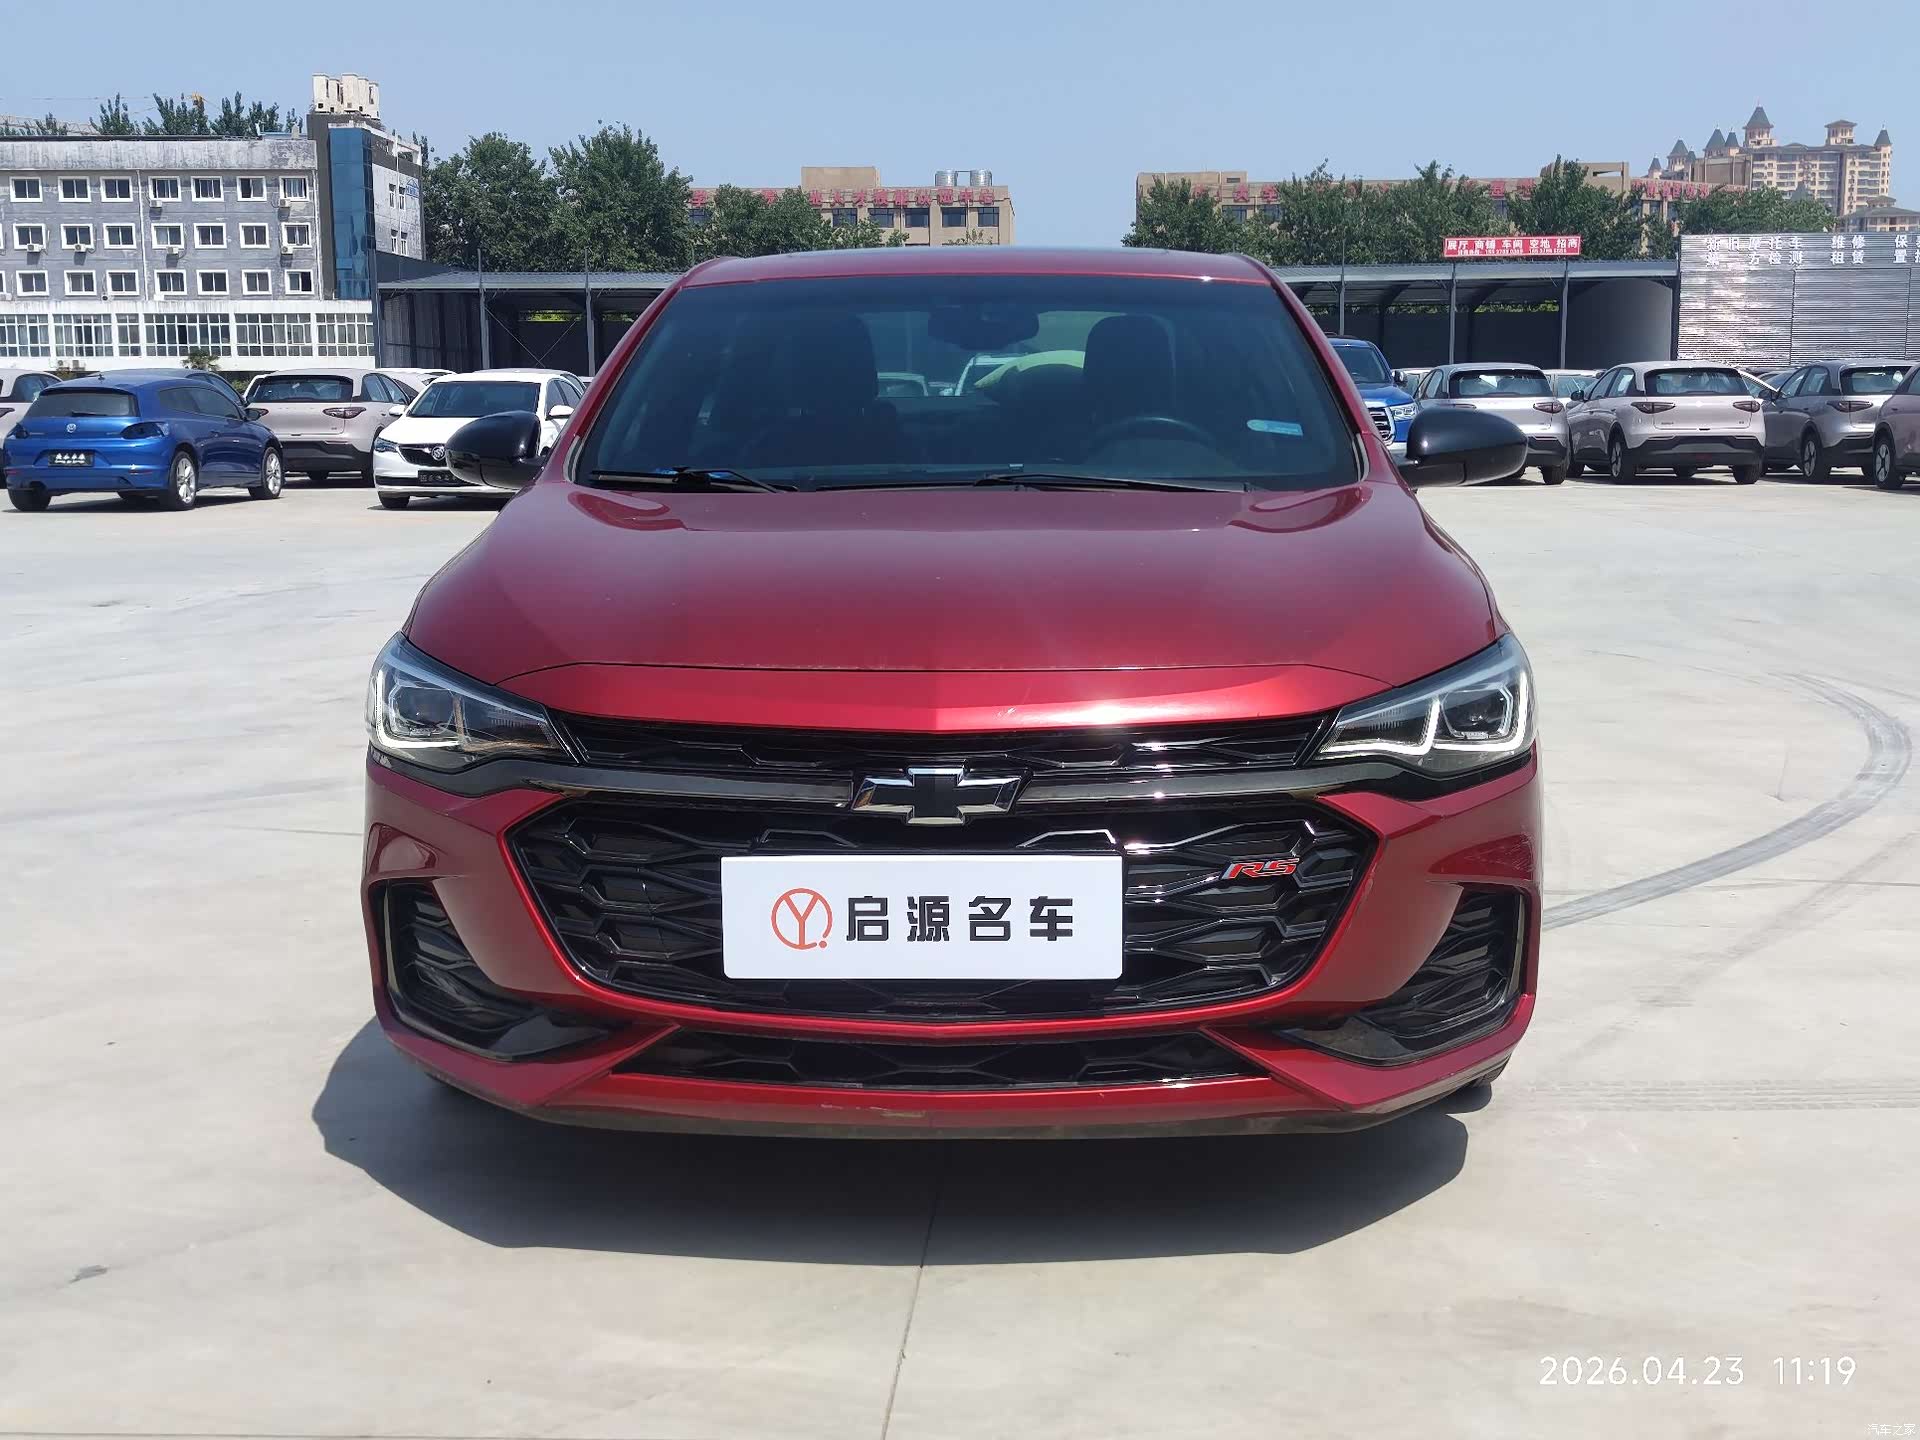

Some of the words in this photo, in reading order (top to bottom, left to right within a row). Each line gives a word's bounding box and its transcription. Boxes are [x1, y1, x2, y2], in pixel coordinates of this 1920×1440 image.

[1448, 240, 1468, 250] 展厅
[1475, 240, 1496, 250] 商铺
[1502, 239, 1523, 249] 车间
[1529, 239, 1550, 248] 空地
[1557, 238, 1578, 248] 招商
[1831, 235, 1866, 249] 维修
[1831, 250, 1865, 265] 租赁
[1222, 857, 1300, 880] RS
[846, 895, 1074, 942] 启源名车
